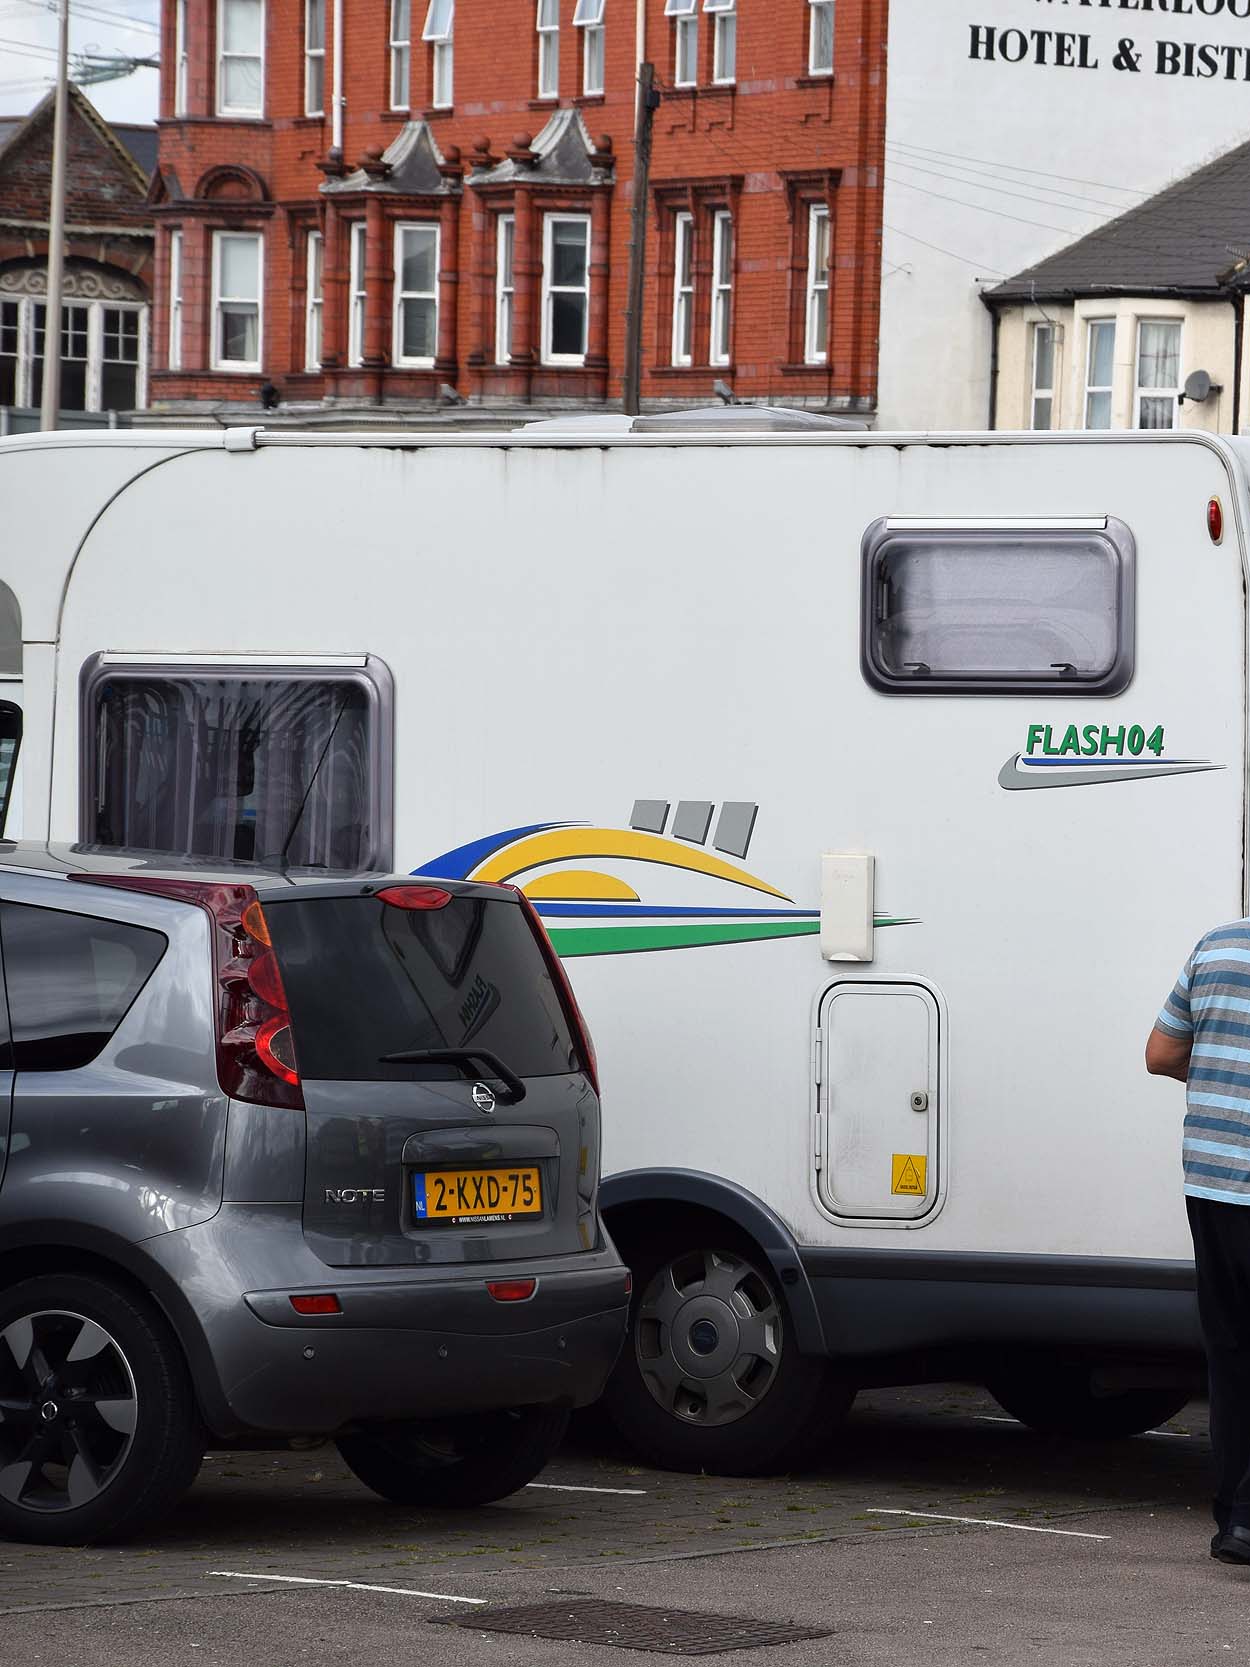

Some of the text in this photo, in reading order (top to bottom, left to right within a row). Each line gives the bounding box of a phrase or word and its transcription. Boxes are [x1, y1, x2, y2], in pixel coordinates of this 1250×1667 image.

[968, 24, 1098, 69] HOTEL
[1112, 37, 1142, 73] &
[1025, 724, 1166, 757] FLASH04
[325, 1188, 385, 1202] NOTE
[415, 1201, 425, 1211] NL
[434, 1174, 534, 1211] 2-KXD-75
